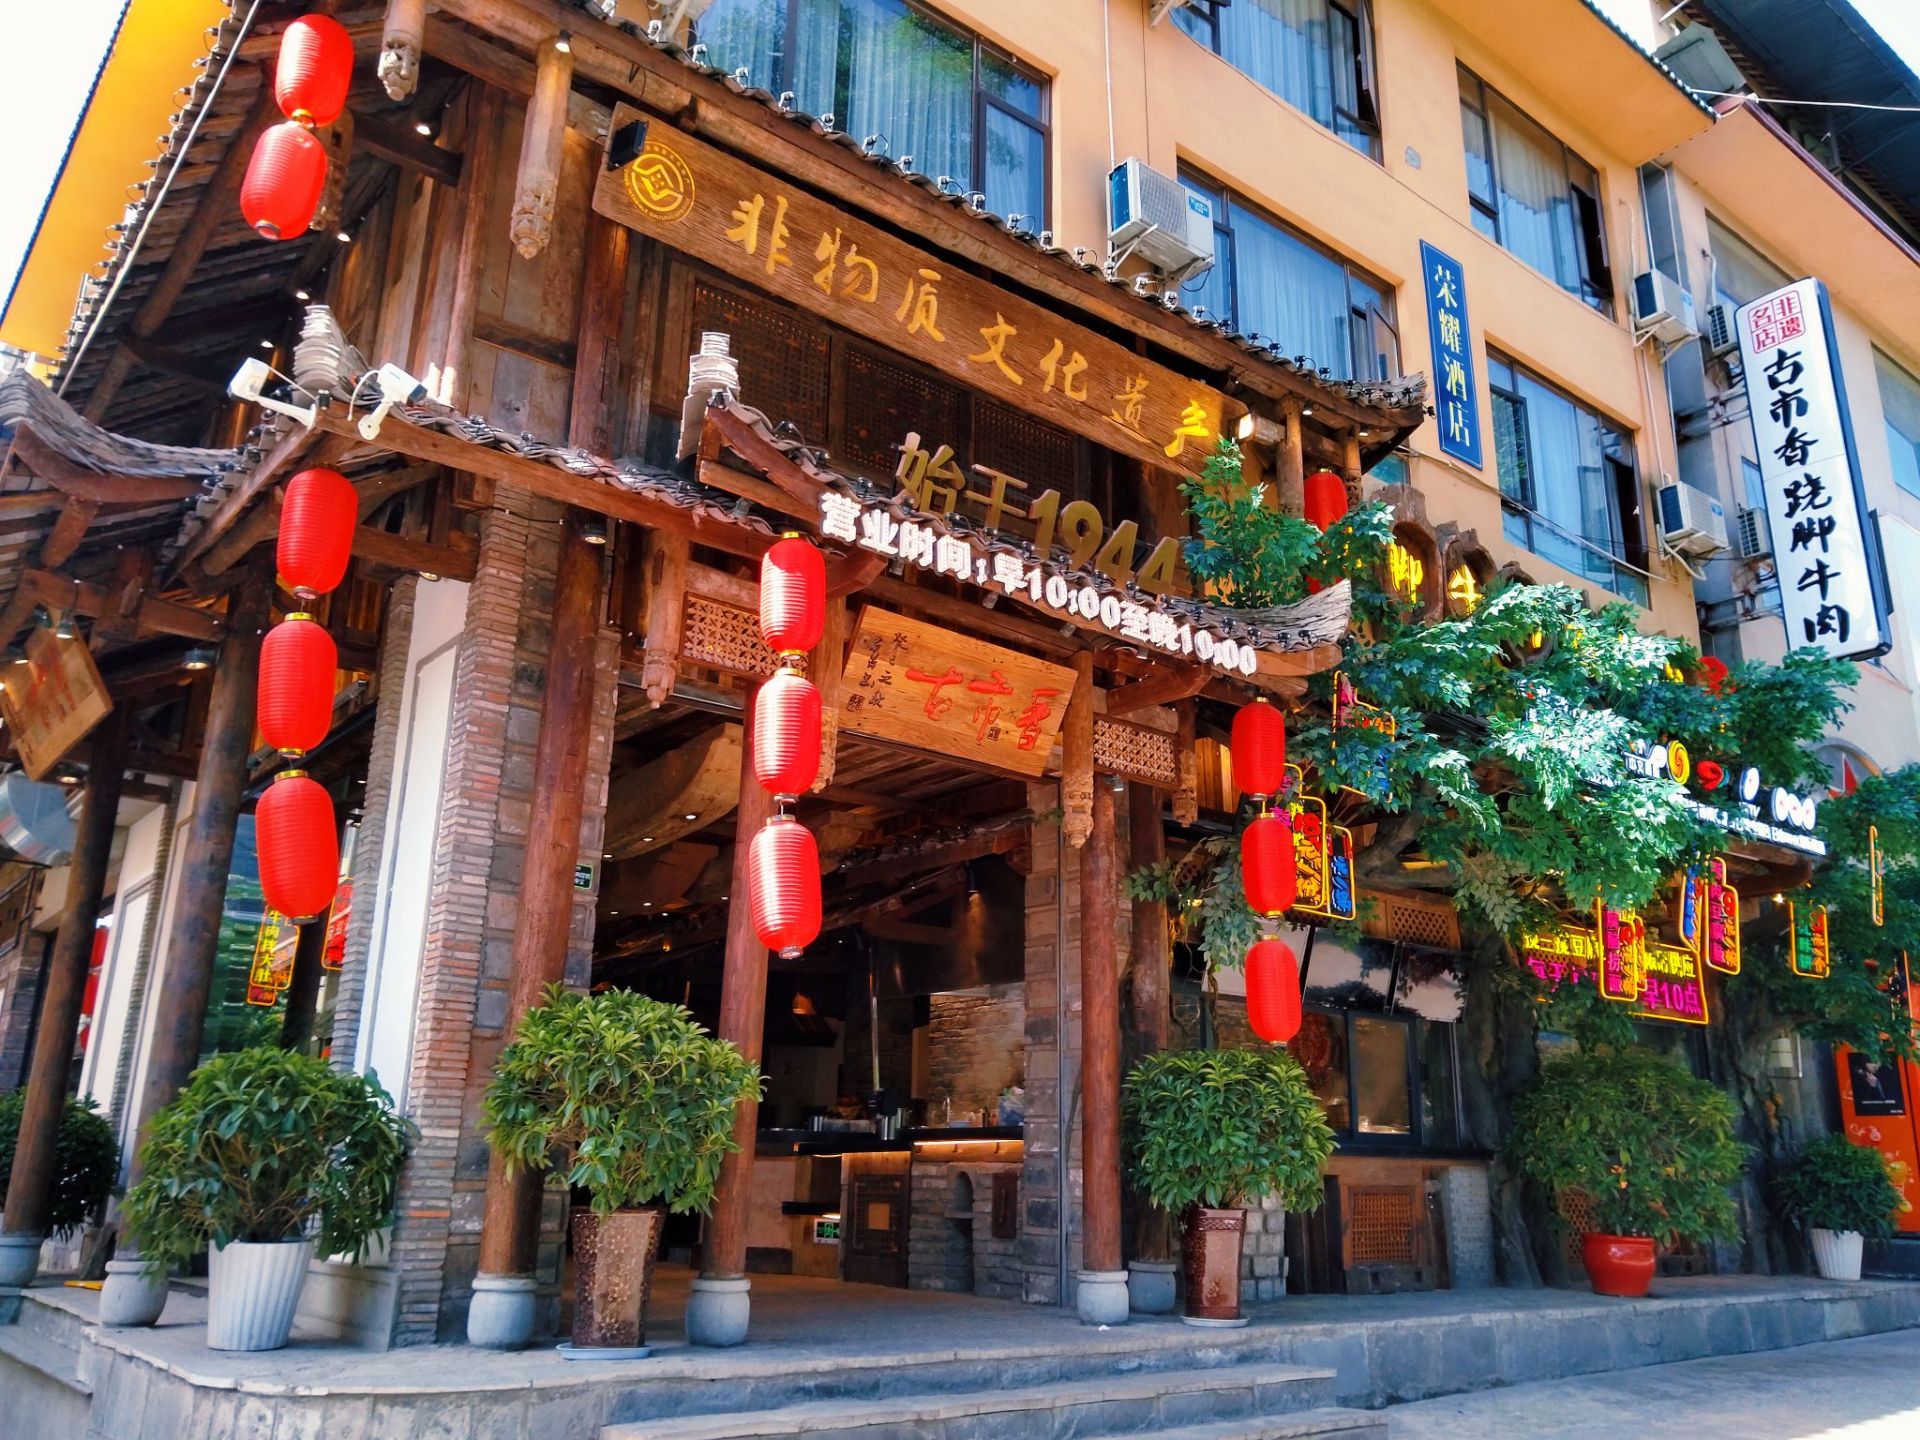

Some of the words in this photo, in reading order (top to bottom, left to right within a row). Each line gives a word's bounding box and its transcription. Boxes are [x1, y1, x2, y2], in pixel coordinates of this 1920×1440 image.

[725, 193, 1212, 458] 非物质文化遗产
[1433, 263, 1472, 448] 荣耀酒店
